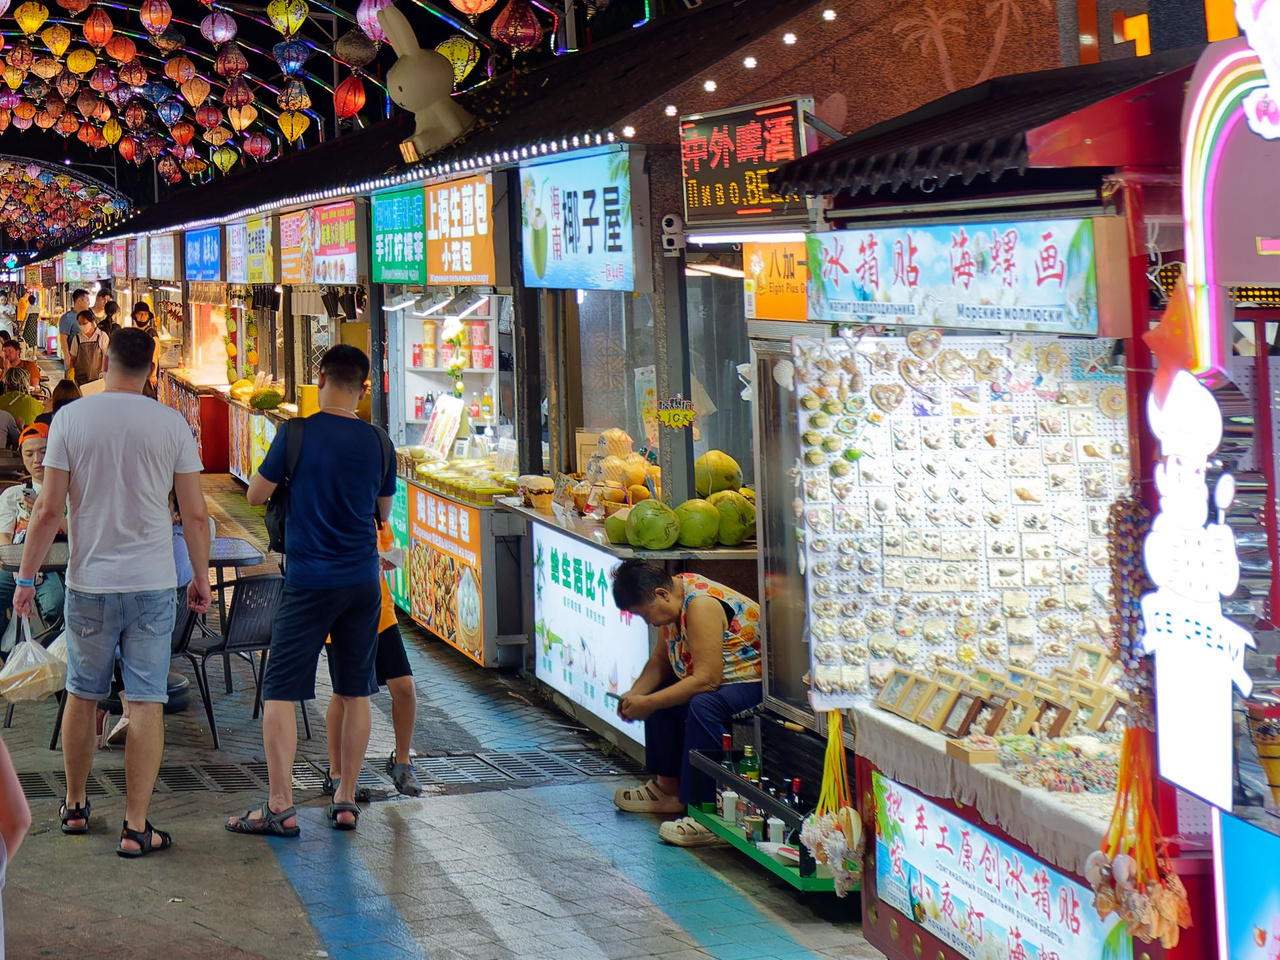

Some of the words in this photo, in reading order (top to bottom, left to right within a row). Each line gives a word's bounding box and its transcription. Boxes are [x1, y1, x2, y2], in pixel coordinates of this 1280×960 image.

[427, 182, 488, 240] 上海生煎包
[562, 186, 623, 254] 椰子屋
[375, 231, 424, 262] 手打柠檬茶
[441, 240, 473, 271] 小笼包
[821, 232, 920, 290] 冰箱贴
[949, 226, 1066, 290] 海螺画
[956, 304, 1001, 320] Морские
[1004, 308, 1064, 323] моллюски
[886, 784, 909, 886] 批发
[914, 804, 1081, 936] 手工原创冰箱贴
[912, 870, 985, 942] 小夜灯
